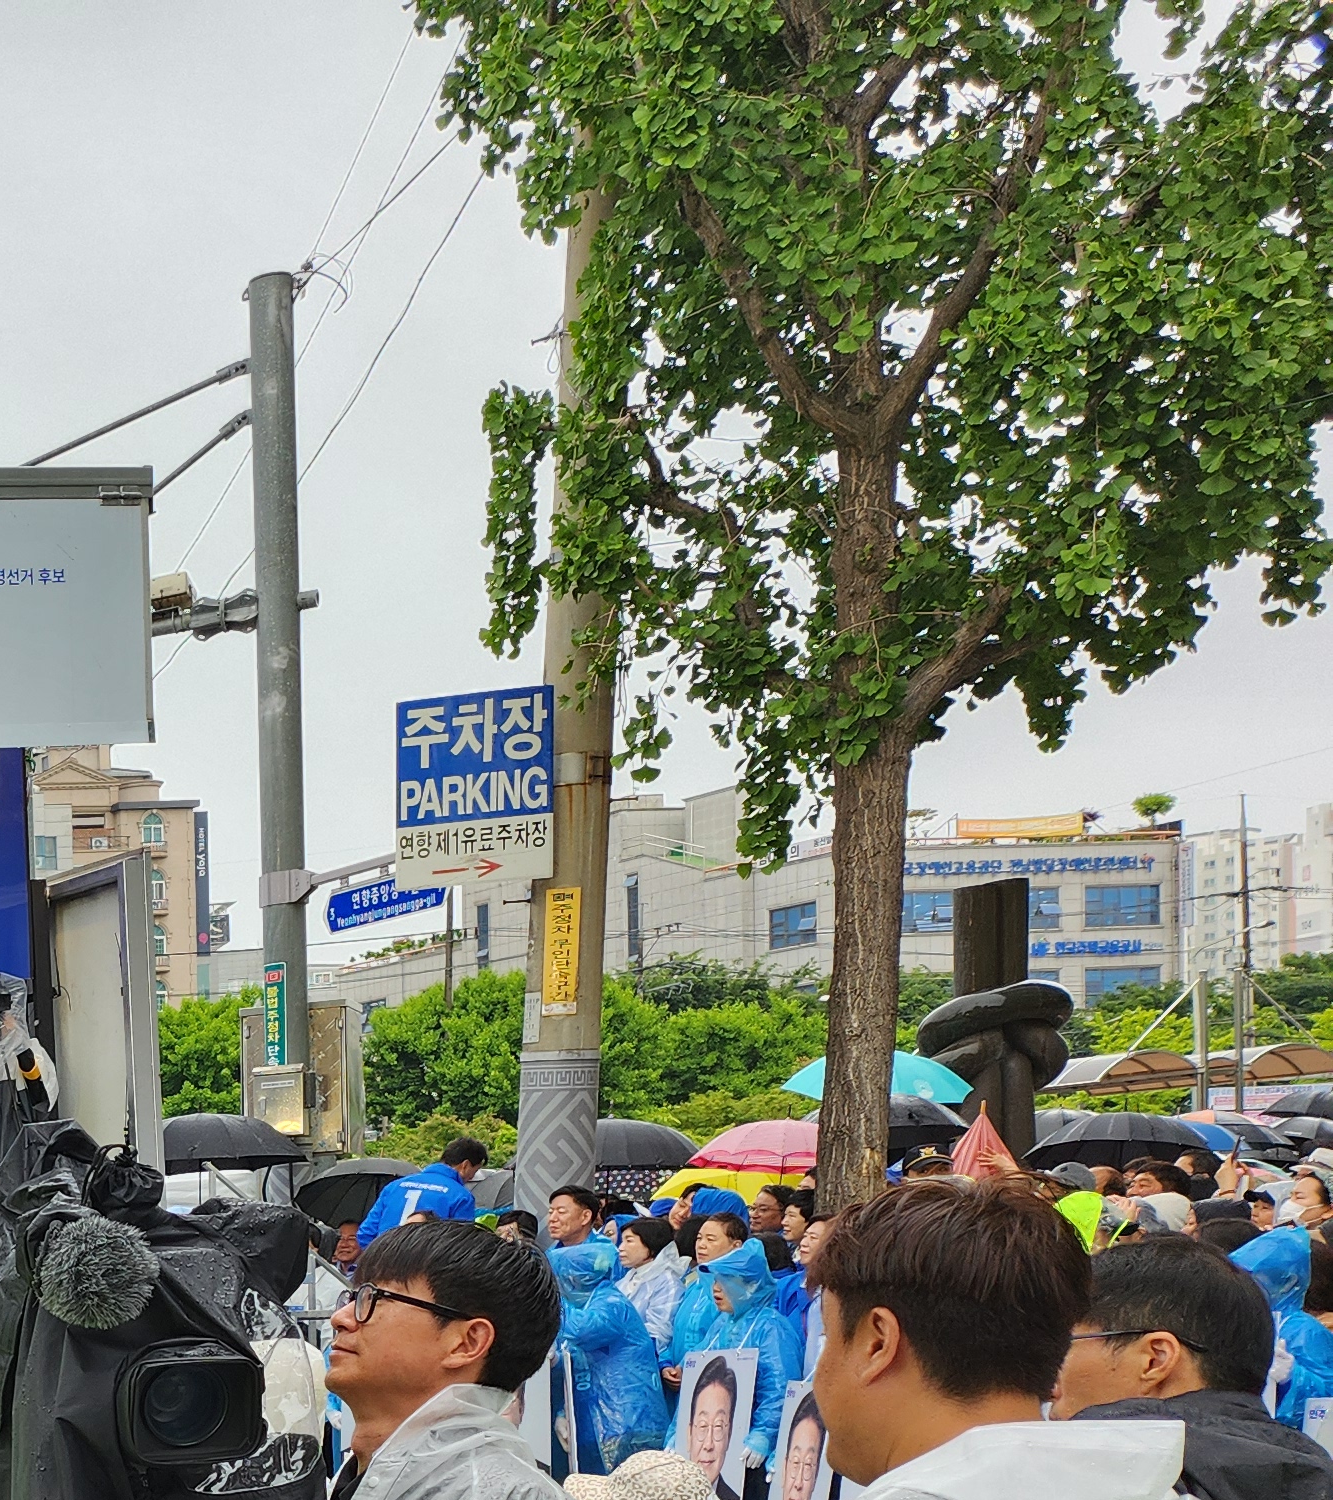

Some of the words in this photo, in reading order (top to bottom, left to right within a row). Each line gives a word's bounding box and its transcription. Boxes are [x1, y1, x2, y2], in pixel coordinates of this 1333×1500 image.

[38, 568, 66, 584] 후보
[401, 693, 548, 769] 주차장
[400, 766, 548, 821] PARKING
[399, 830, 432, 860] 연향
[435, 818, 548, 856] 제1유료주차장
[399, 1189, 423, 1227] 1
